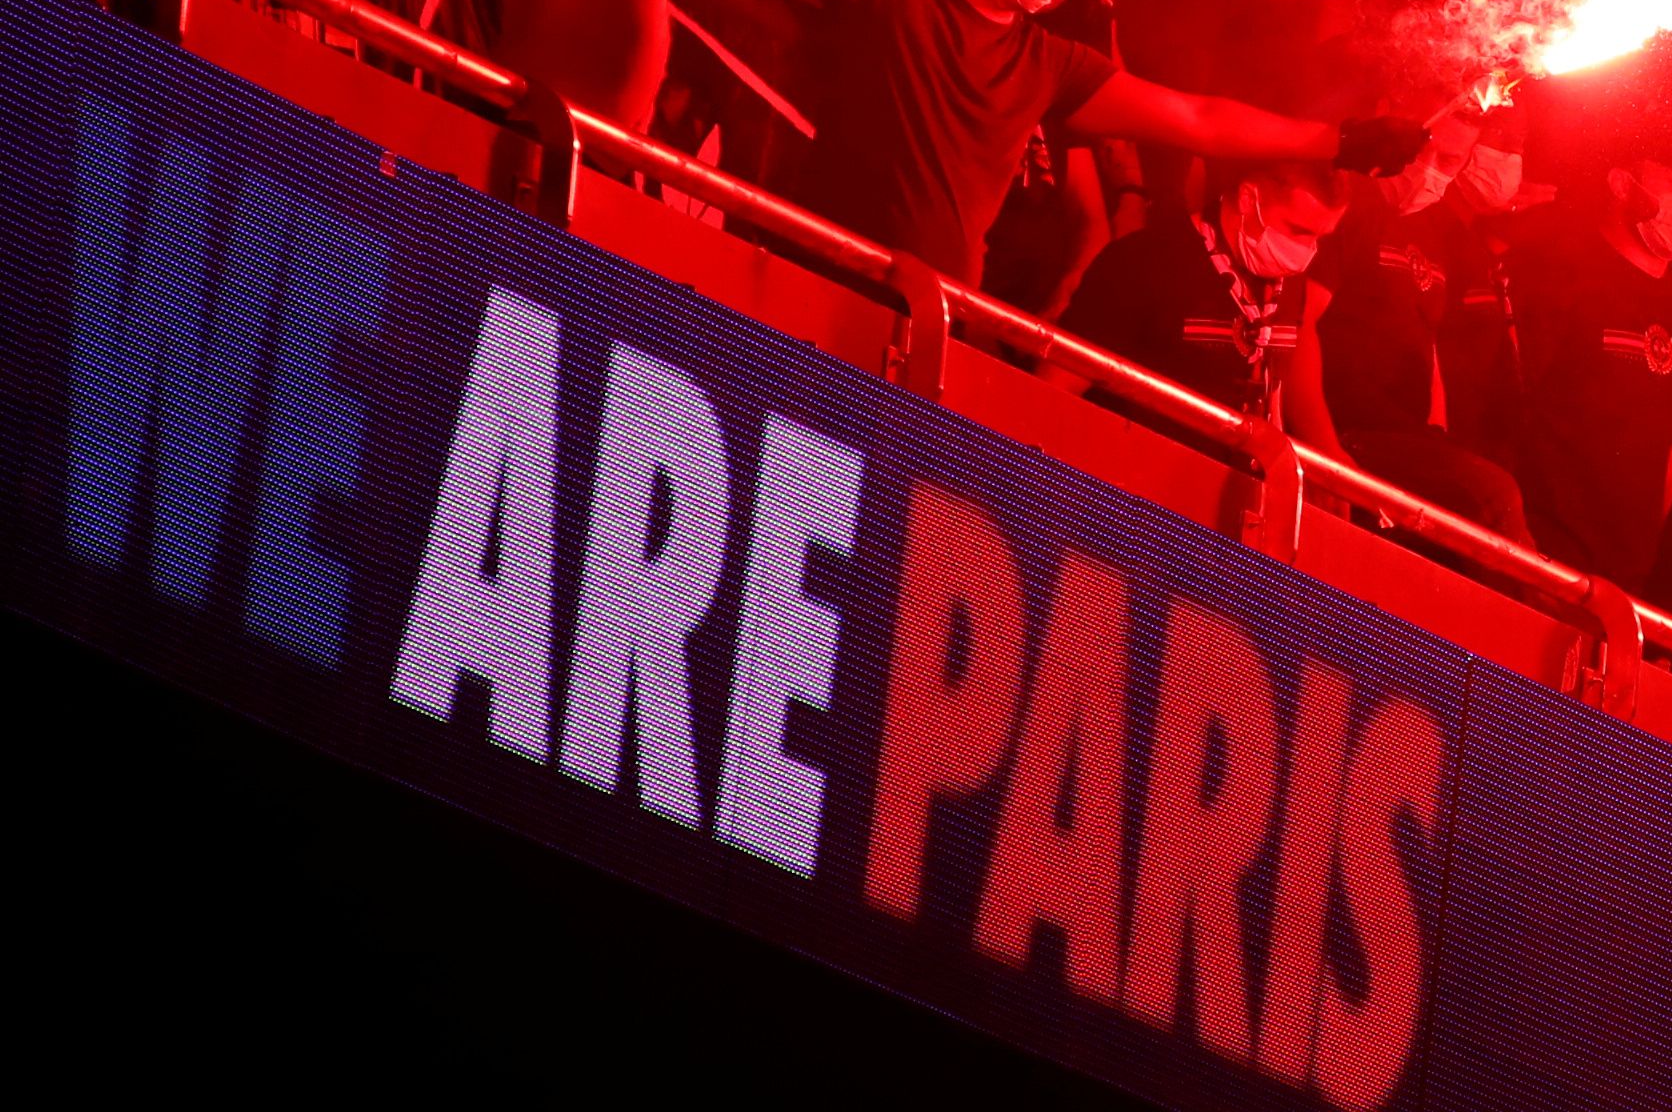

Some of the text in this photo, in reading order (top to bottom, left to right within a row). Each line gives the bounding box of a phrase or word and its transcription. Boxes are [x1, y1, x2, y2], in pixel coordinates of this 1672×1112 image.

[64, 90, 1446, 1110] WE ARE PARIS
